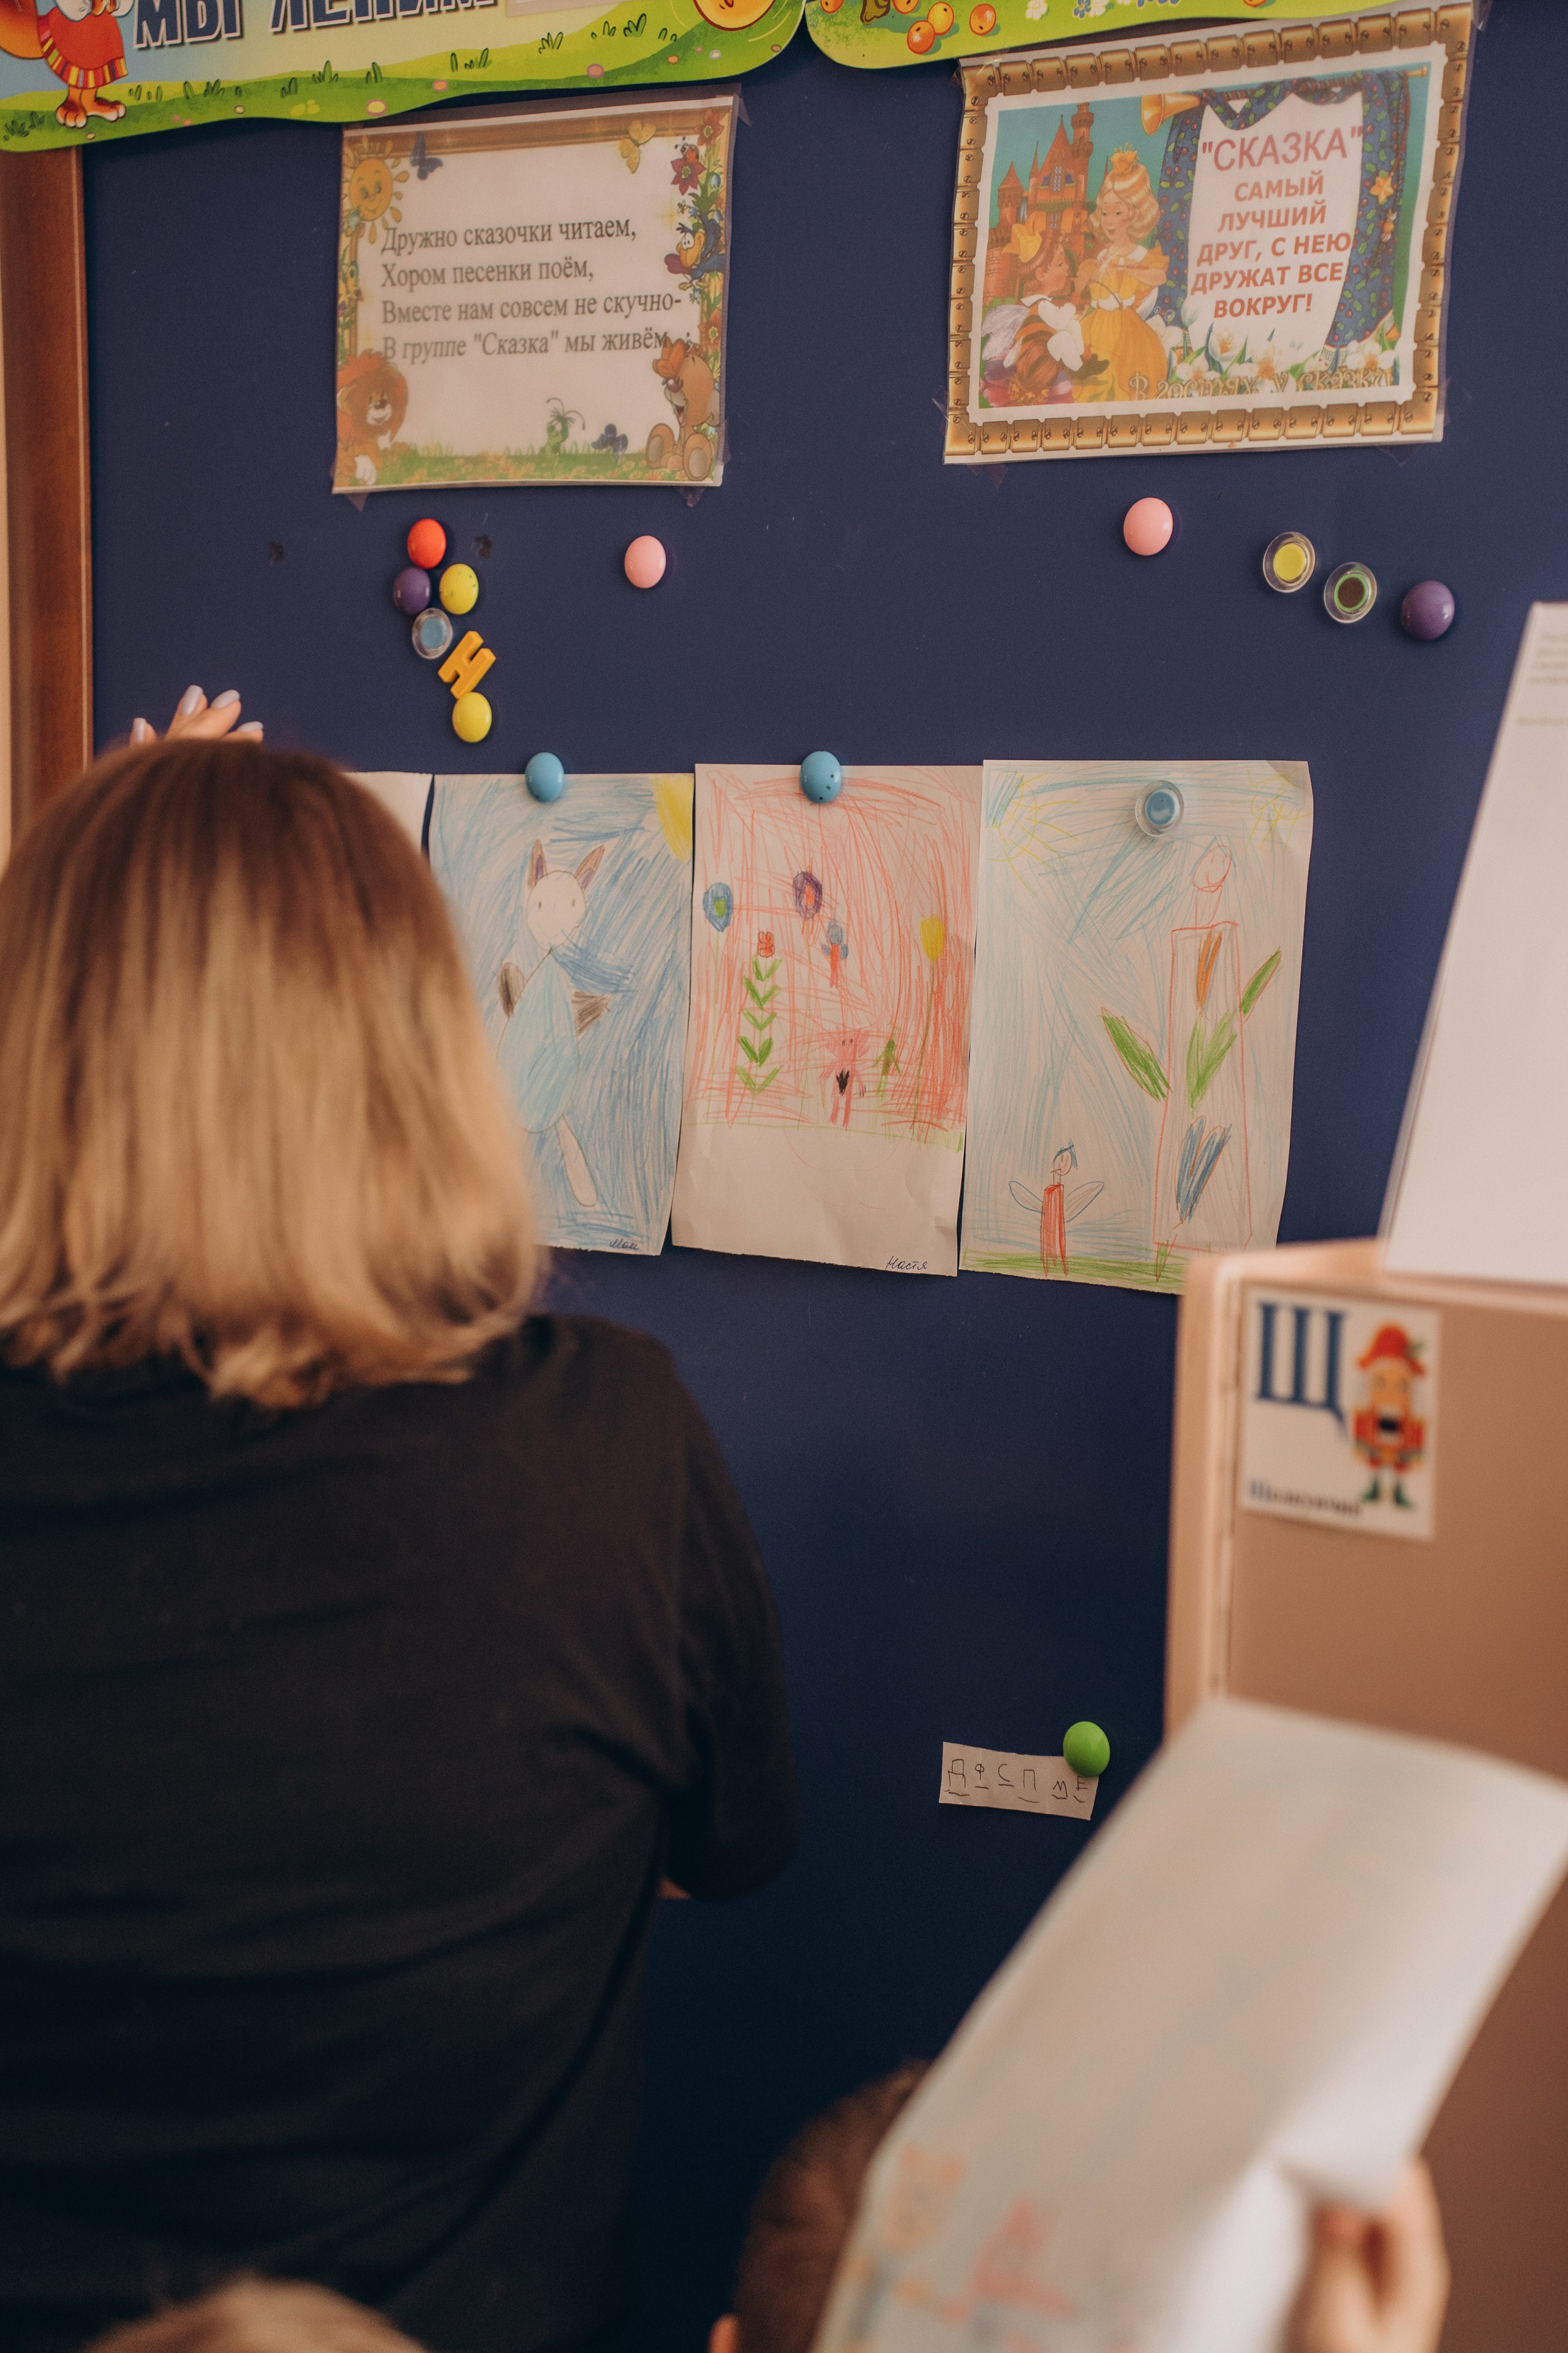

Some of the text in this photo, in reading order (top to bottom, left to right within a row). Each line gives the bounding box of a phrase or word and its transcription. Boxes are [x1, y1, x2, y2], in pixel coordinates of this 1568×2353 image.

[1202, 126, 1363, 172] "СКАЗКА"
[1234, 170, 1325, 202] САМЫЙ
[1217, 199, 1327, 233] ЛУЧШИЙ
[380, 219, 636, 257] Дружно сказочки читаем,
[1196, 232, 1352, 267] ДРУГ, С НЕЮ
[381, 256, 594, 293] Хором песенки поём,
[1190, 262, 1344, 296] ДРУЖАТ ВСЕ
[382, 293, 681, 324] Вместе нам совсем не скучно-
[1213, 293, 1313, 319] ВОКРУГ!
[383, 336, 397, 360] В
[402, 339, 467, 365] группе
[473, 329, 559, 356] "Сказка"
[565, 334, 595, 353] мы
[884, 1255, 928, 1270] Настя
